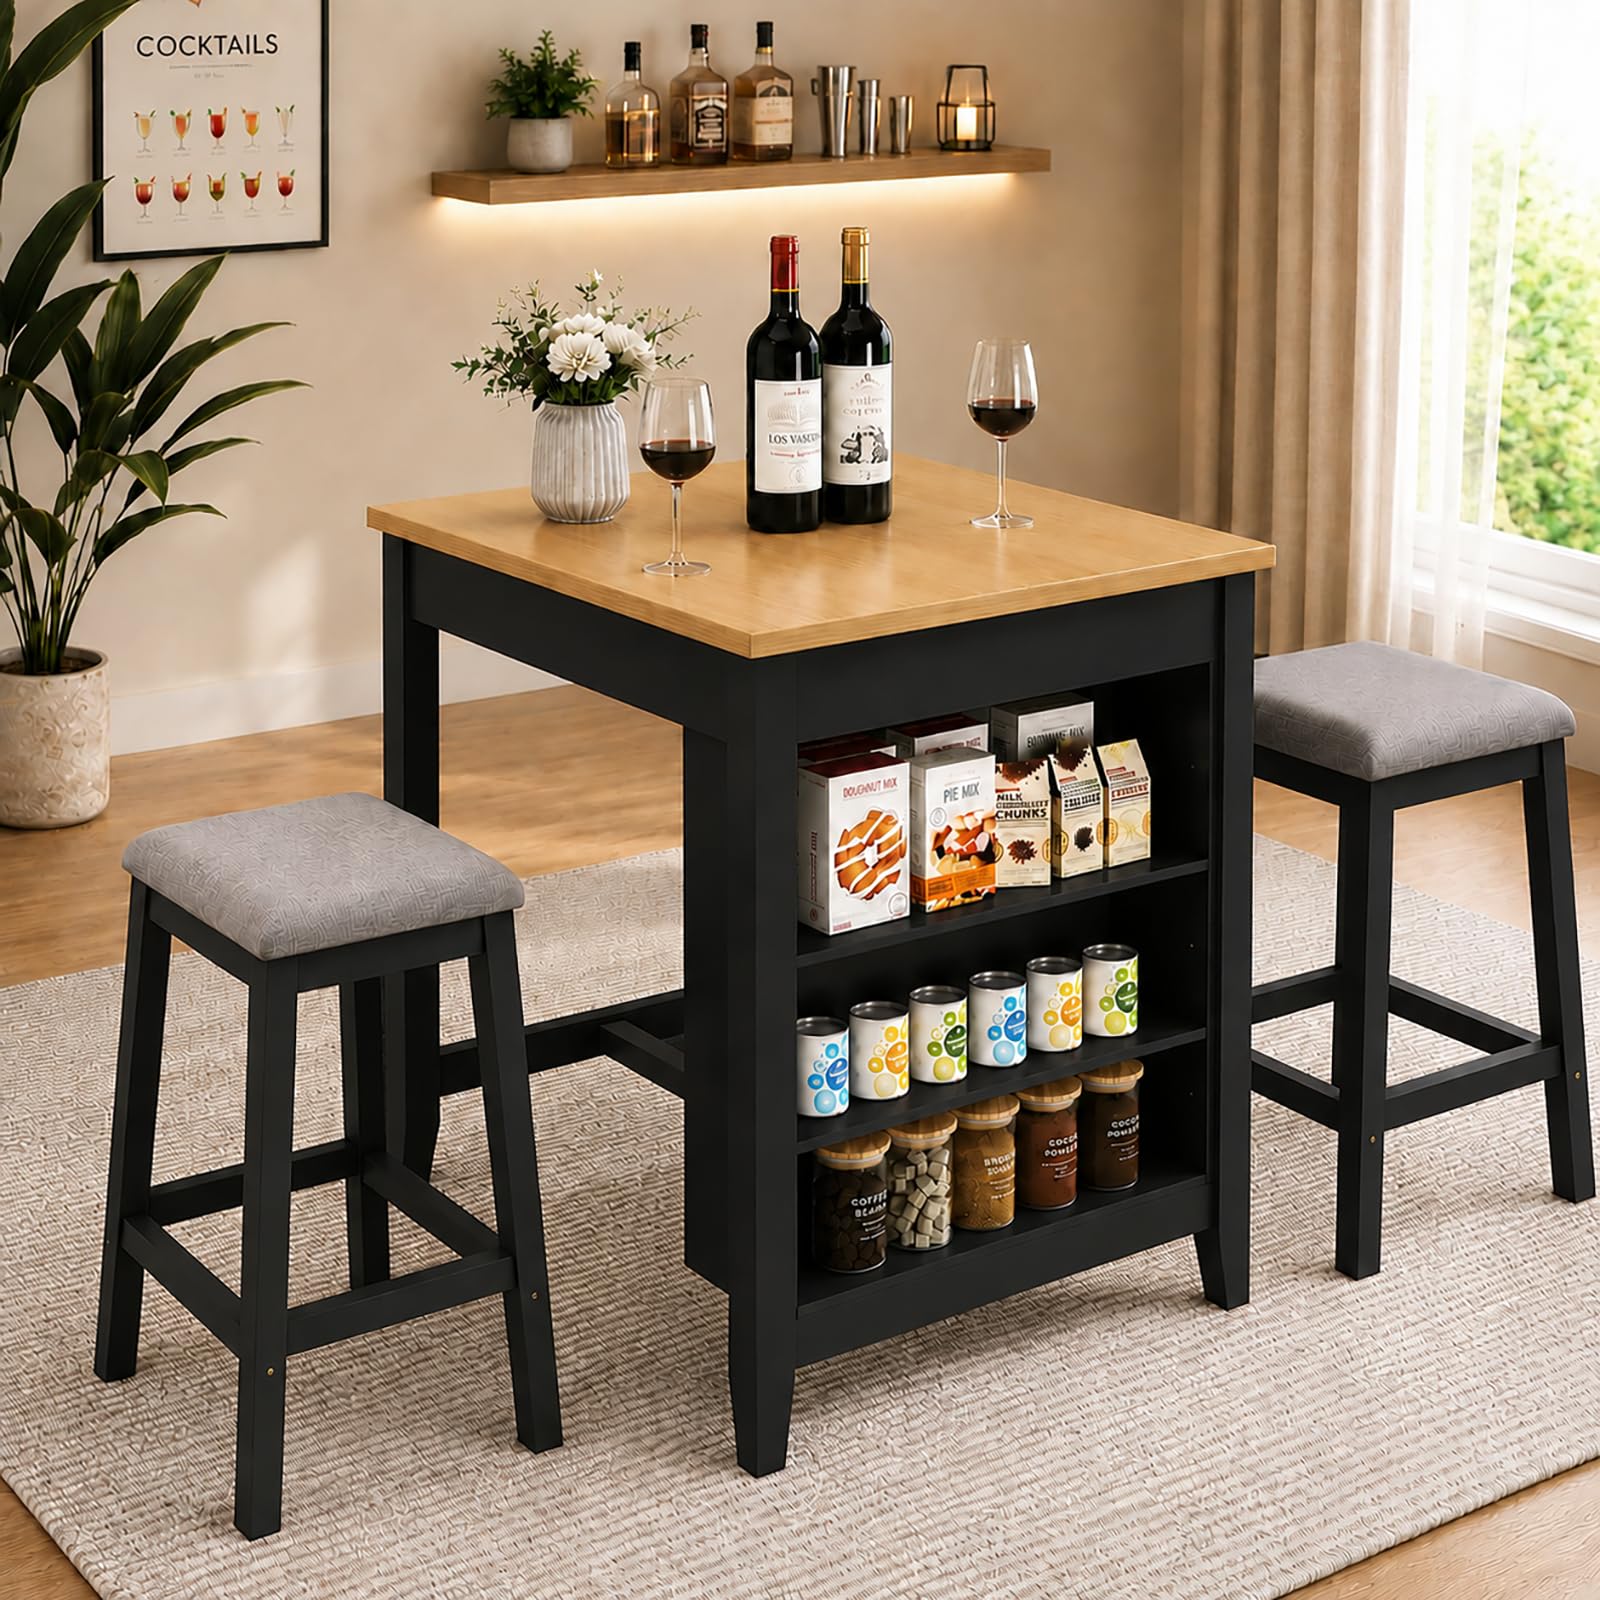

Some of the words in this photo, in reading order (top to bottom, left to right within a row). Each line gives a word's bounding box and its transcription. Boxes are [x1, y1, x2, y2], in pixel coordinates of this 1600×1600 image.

[136, 33, 279, 57] COCKTAILS
[768, 433, 788, 445] LOS
[843, 780, 881, 798] DOUGHNUT
[882, 777, 898, 790] MIX
[943, 786, 960, 803] PIE
[961, 782, 980, 799] MIX
[995, 808, 1047, 819] CHUNKS
